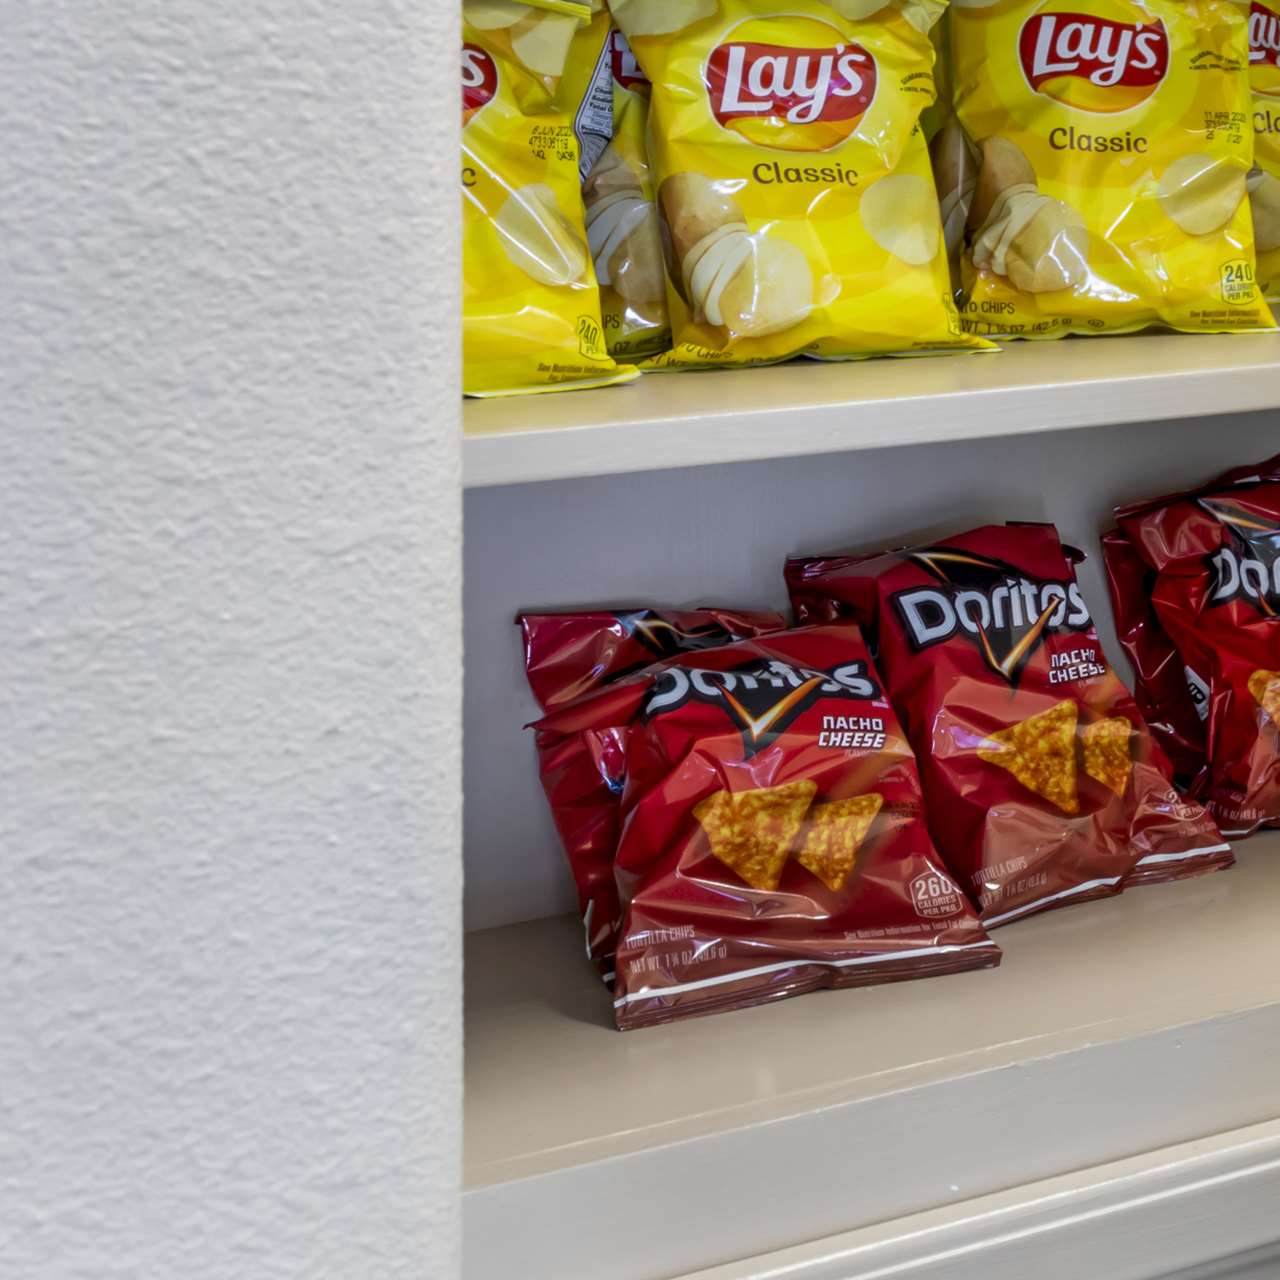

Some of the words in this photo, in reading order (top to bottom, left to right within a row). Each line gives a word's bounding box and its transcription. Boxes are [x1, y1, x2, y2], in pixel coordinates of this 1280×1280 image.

[1033, 14, 1160, 86] Lay's
[720, 44, 865, 123] Lay's
[1048, 127, 1148, 154] Classic
[753, 162, 858, 187] Classic
[1224, 263, 1253, 283] 240
[981, 302, 1015, 314] CHIPS
[578, 316, 598, 345] 240
[899, 578, 1090, 644] Doritos
[1051, 648, 1096, 668] NACHO
[1049, 663, 1105, 684] CHEESE
[822, 716, 884, 731] NACHO
[818, 731, 887, 748] CHEESE
[915, 877, 953, 900] 260
[918, 895, 958, 909] CALORIES
[923, 907, 939, 915] PER
[669, 924, 696, 940] CHIPS
[630, 957, 646, 974] NET
